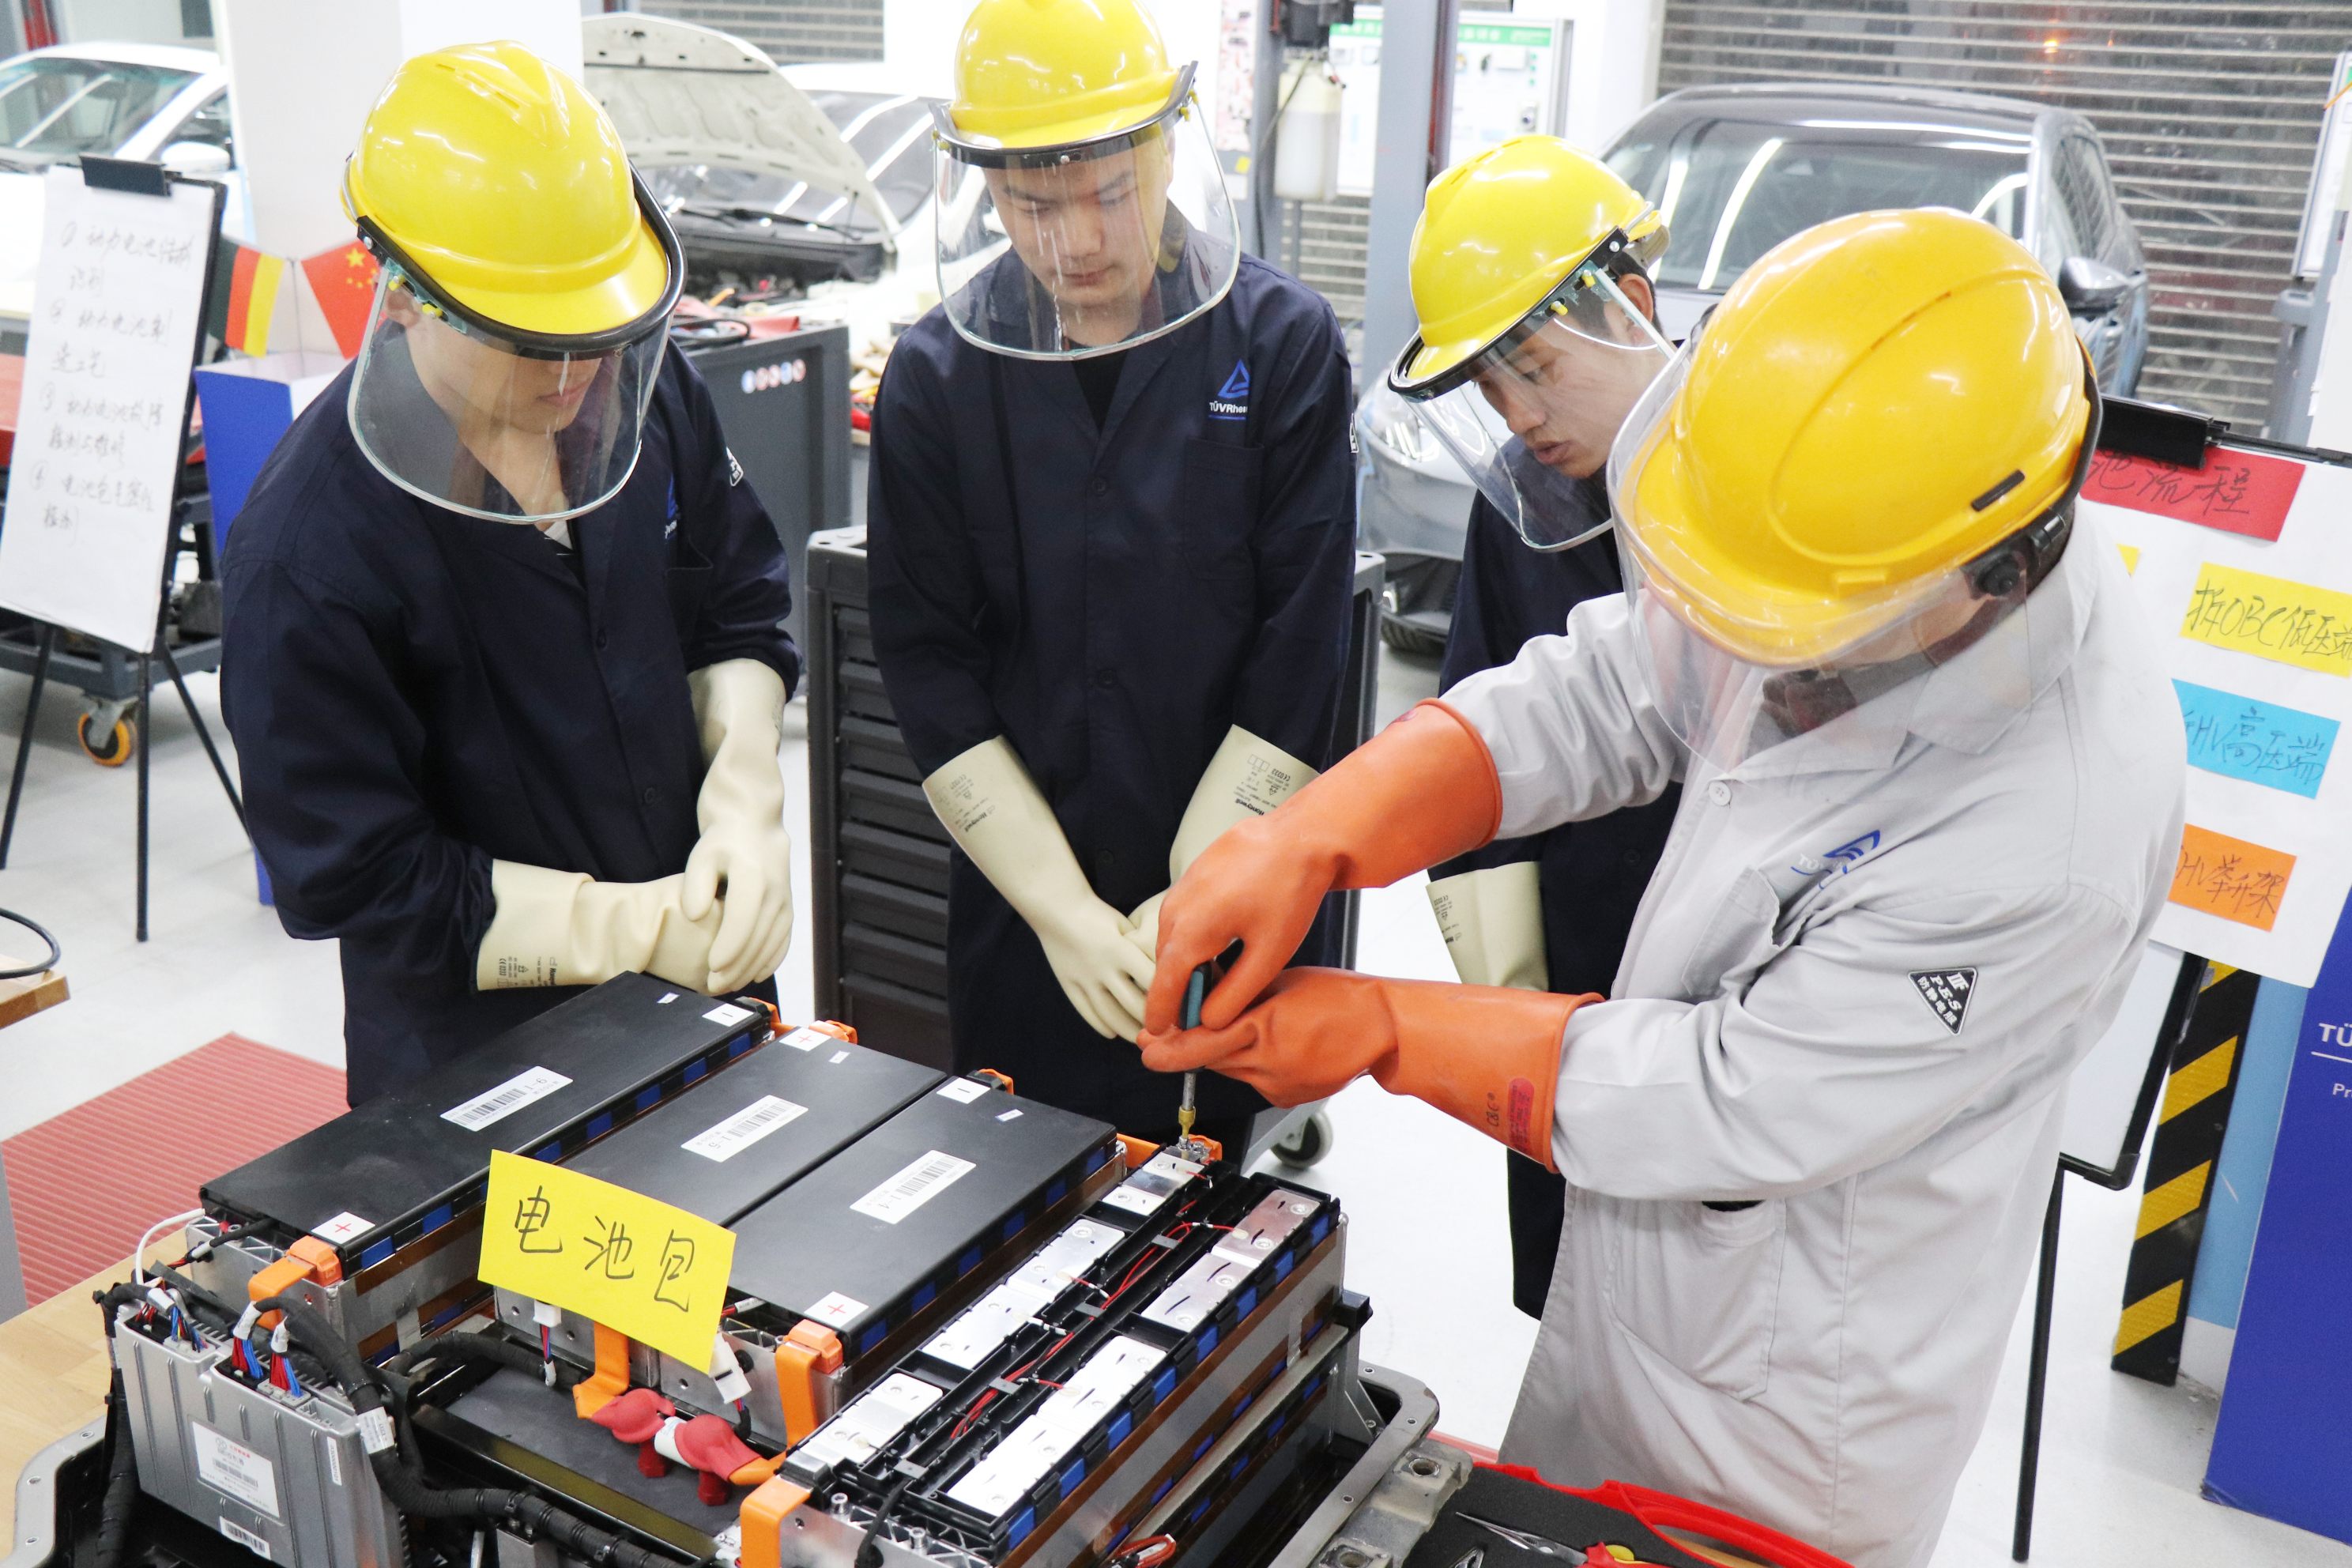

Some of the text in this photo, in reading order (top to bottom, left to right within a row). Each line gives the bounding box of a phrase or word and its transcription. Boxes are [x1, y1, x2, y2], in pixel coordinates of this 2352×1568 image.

[1234, 797, 1265, 816] Honeywell
[2176, 844, 2285, 918] HV举升架
[1917, 977, 1958, 1026] 防静电服
[2331, 1082, 2352, 1099] Pr
[514, 1185, 695, 1313] 电池包
